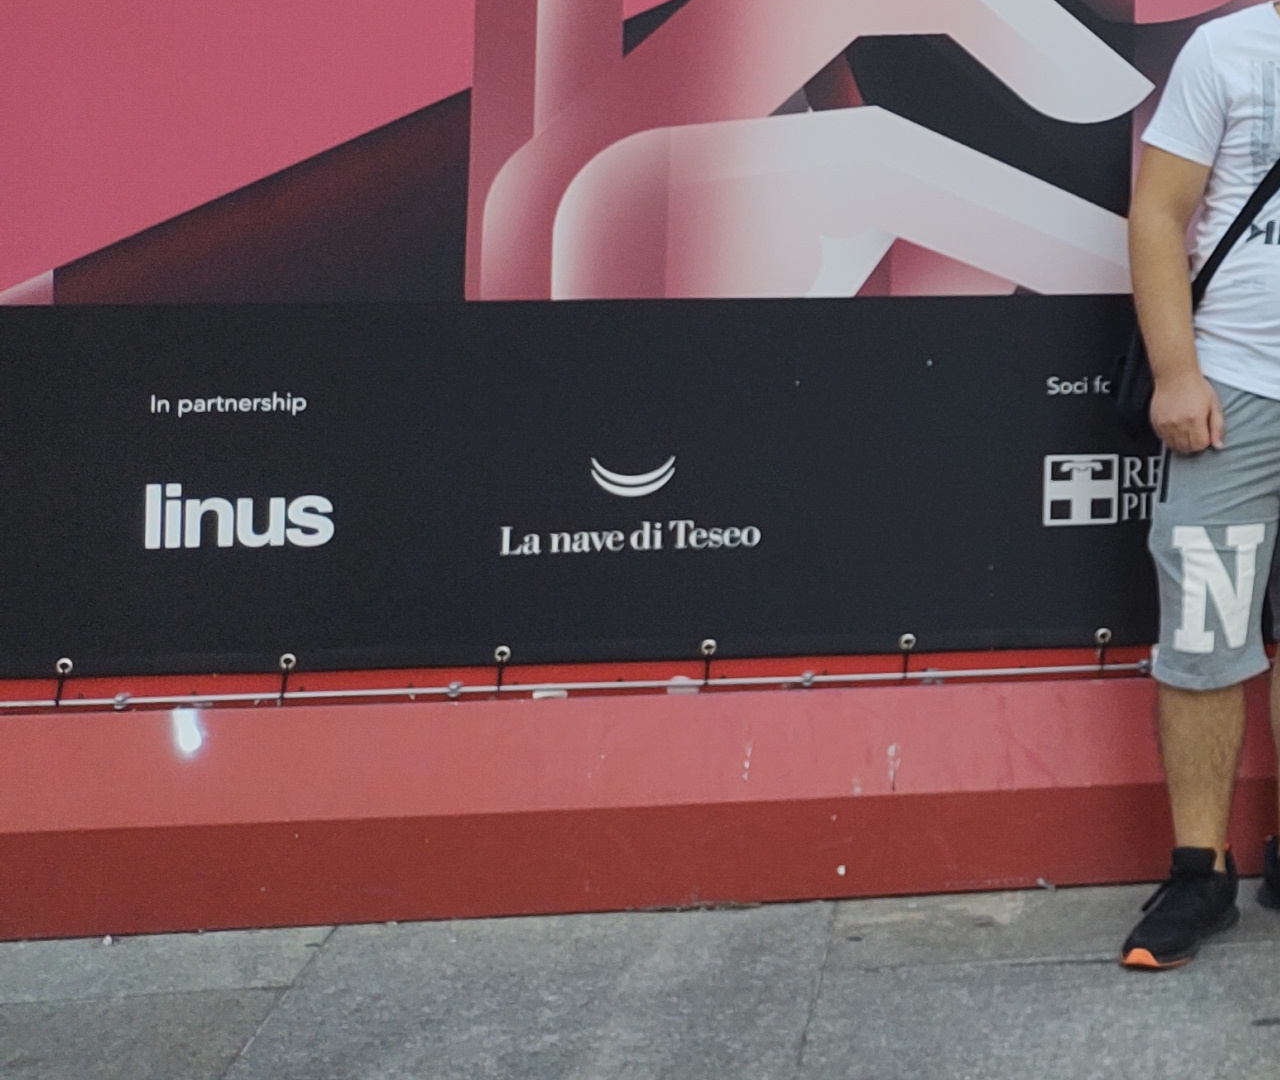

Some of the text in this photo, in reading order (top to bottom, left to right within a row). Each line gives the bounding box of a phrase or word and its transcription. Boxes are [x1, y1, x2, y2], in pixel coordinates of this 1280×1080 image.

[1046, 376, 1088, 395] Soci
[150, 391, 307, 418] In partnership
[144, 483, 335, 550] linus
[500, 519, 761, 556] La nave di Teseo
